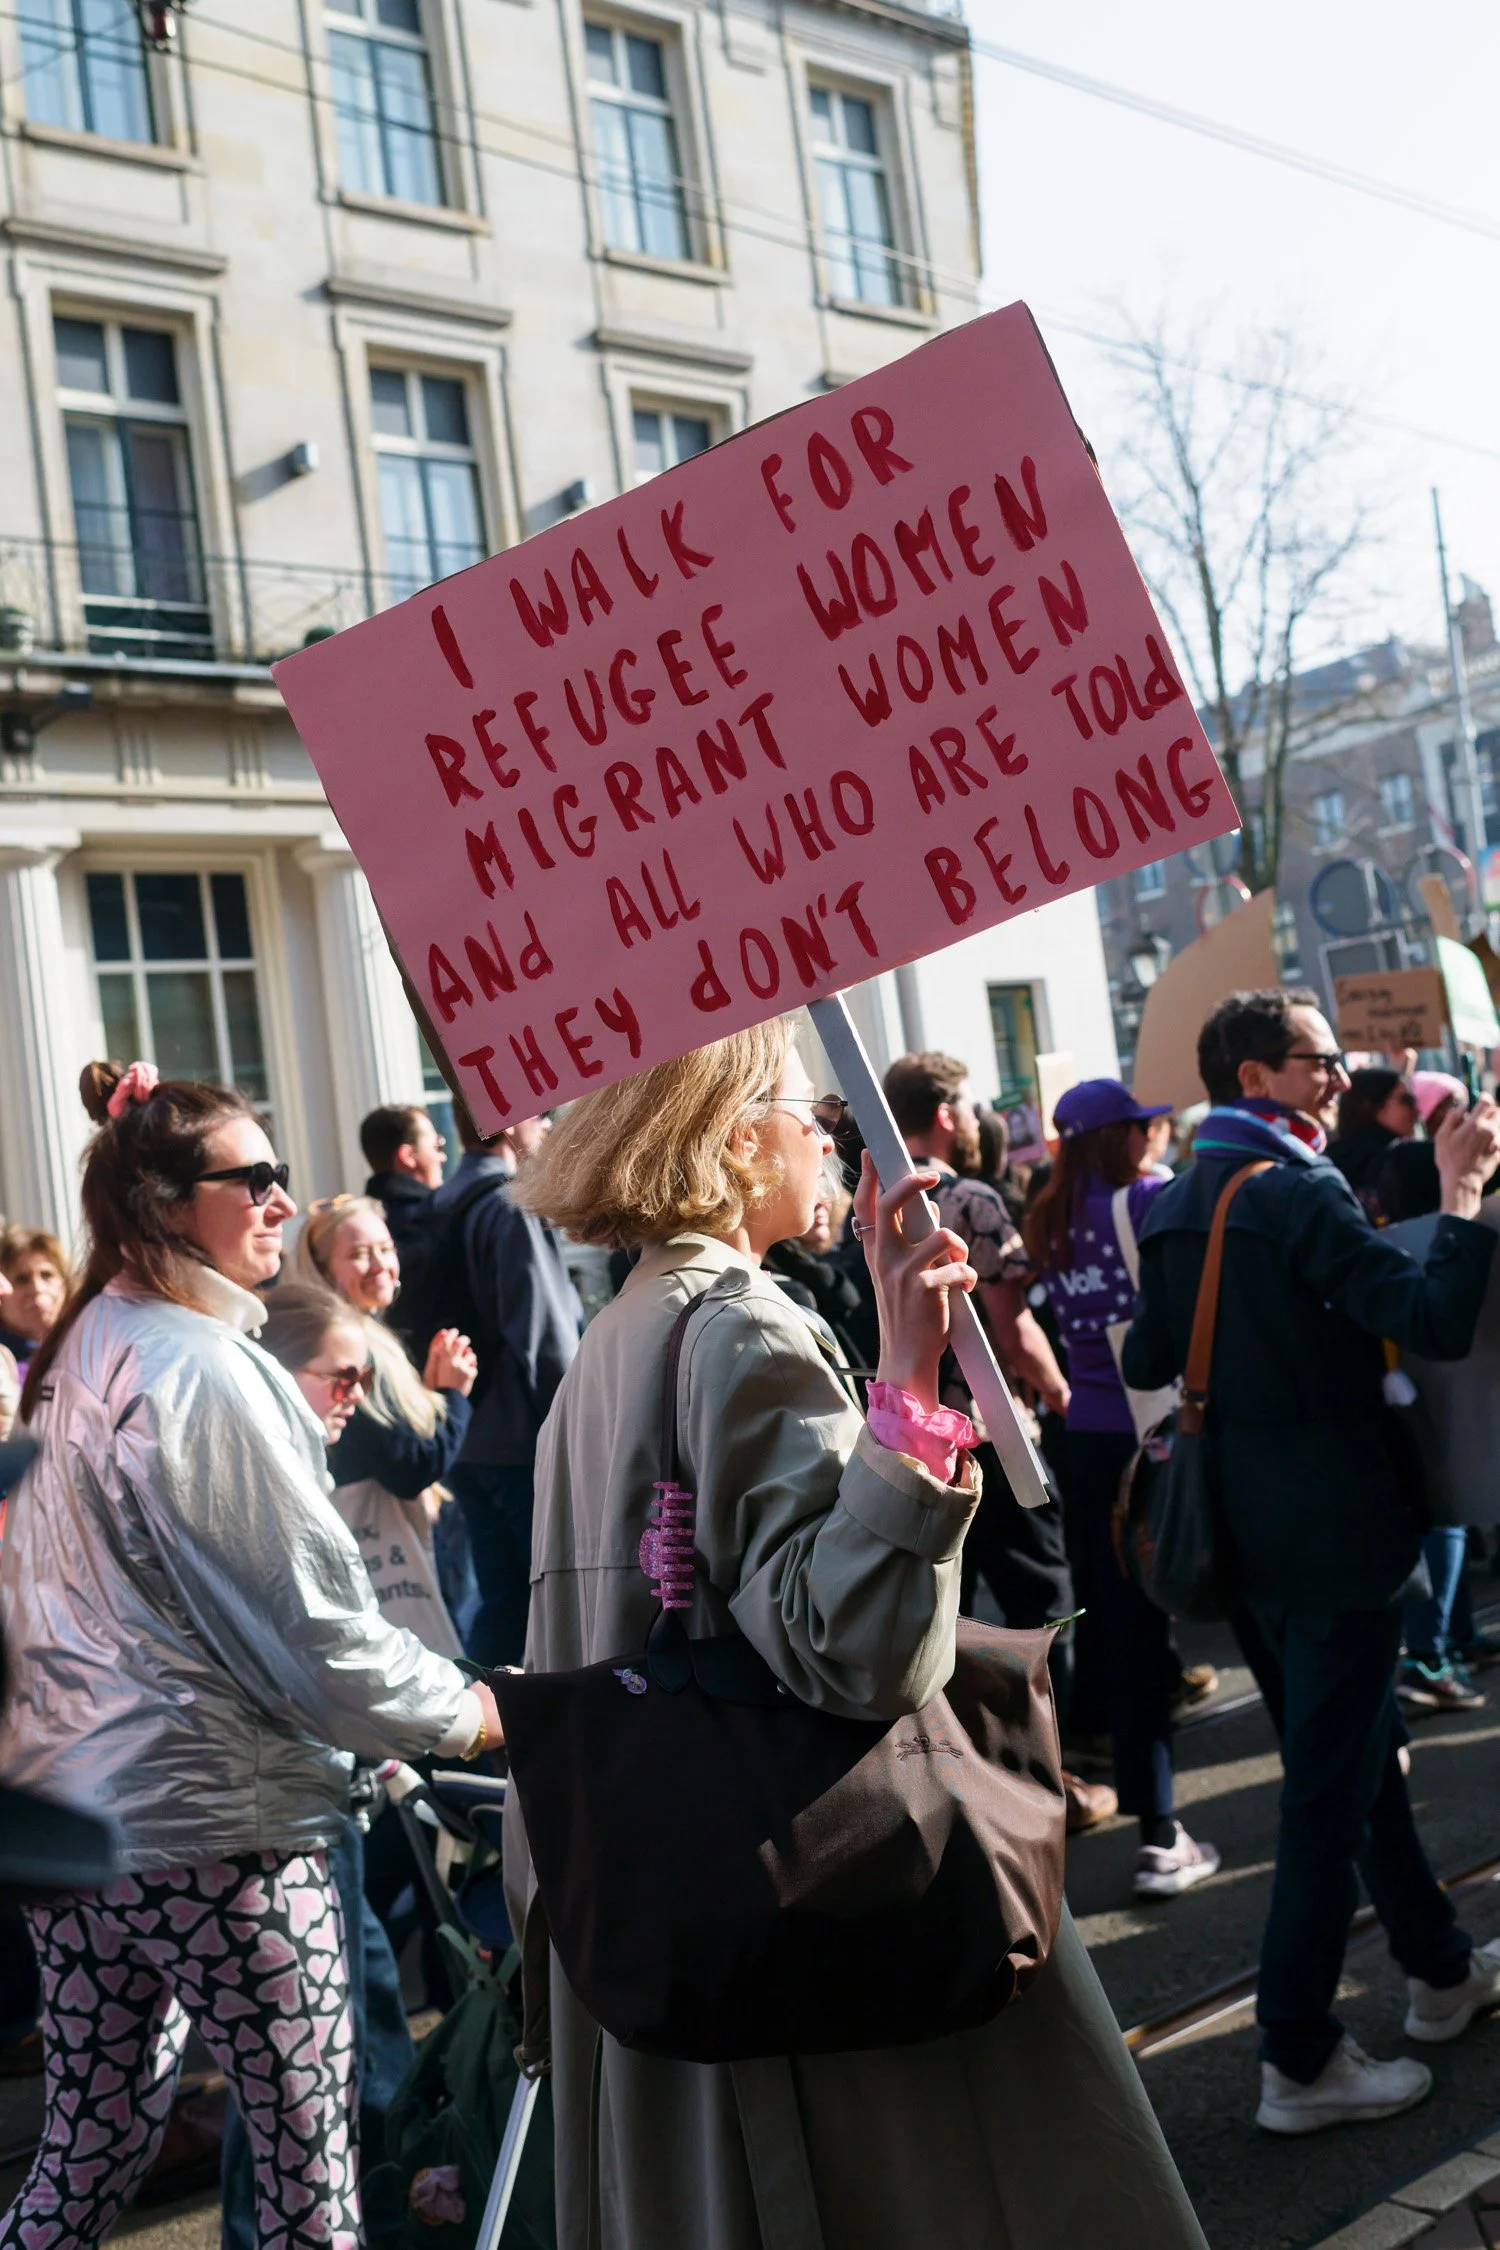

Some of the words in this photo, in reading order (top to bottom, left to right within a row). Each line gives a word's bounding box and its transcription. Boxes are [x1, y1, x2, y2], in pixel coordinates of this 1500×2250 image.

[424, 603, 749, 808] REFUGEE
[796, 455, 1049, 642] WOMEN
[431, 604, 476, 690] I
[508, 499, 715, 648] WALK
[760, 406, 915, 535] FOR
[464, 691, 788, 900] MIGRANT
[837, 559, 1090, 728] WOMEN
[605, 847, 702, 949] ALL
[732, 769, 876, 885] WHO
[908, 703, 1029, 815] ARE
[457, 986, 643, 1117] THEY
[923, 736, 1216, 926] BELONG
